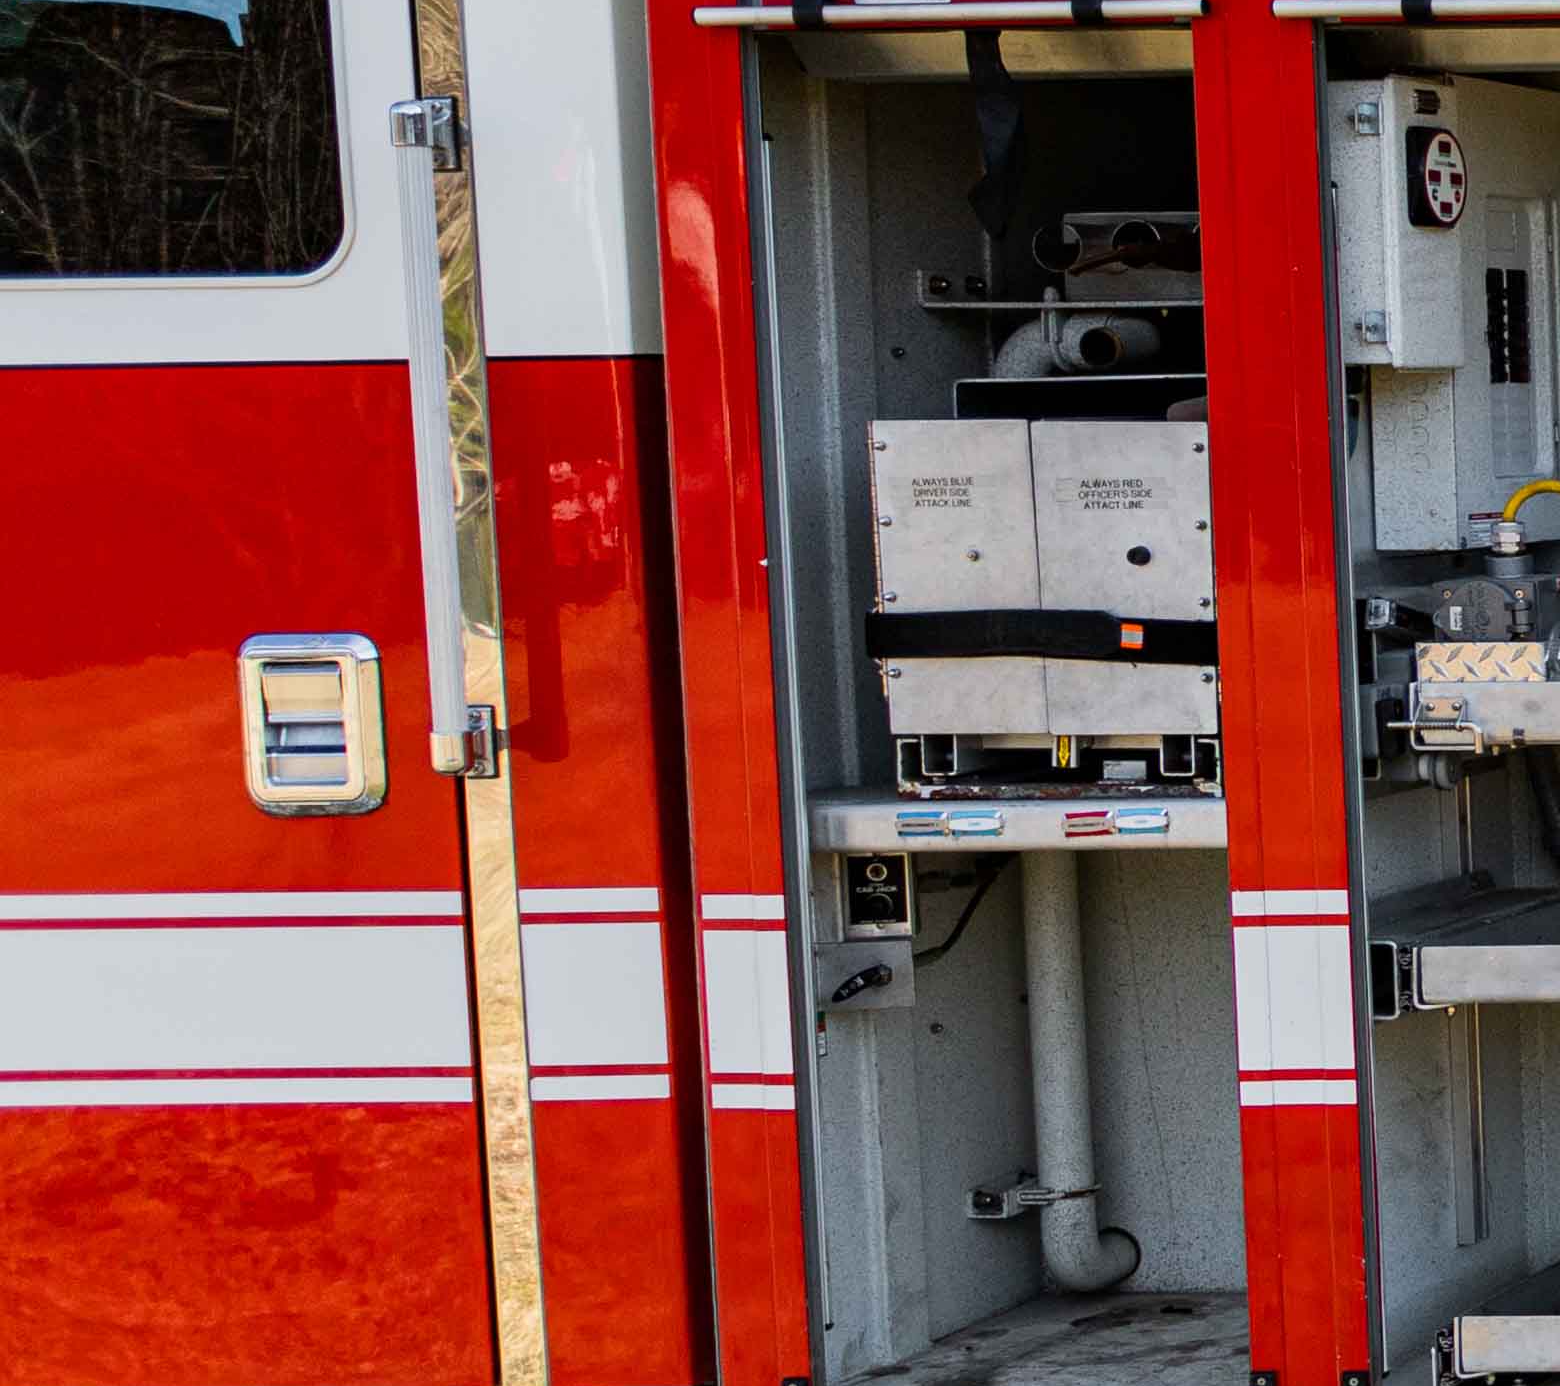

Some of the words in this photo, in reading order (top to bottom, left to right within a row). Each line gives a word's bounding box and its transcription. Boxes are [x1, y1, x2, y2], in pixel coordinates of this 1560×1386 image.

[911, 477, 949, 487] ALWAYS
[950, 476, 974, 486] BLUE
[1080, 479, 1120, 489] ALWAYS
[1122, 479, 1143, 488] RED
[913, 488, 949, 498] DRIVER
[949, 487, 970, 497] SIDE
[1078, 490, 1129, 499] OFFICER'S
[1131, 488, 1153, 499] SIDE
[914, 499, 949, 508] ATTACK
[951, 498, 973, 508] LINE
[1122, 500, 1144, 509] LINE
